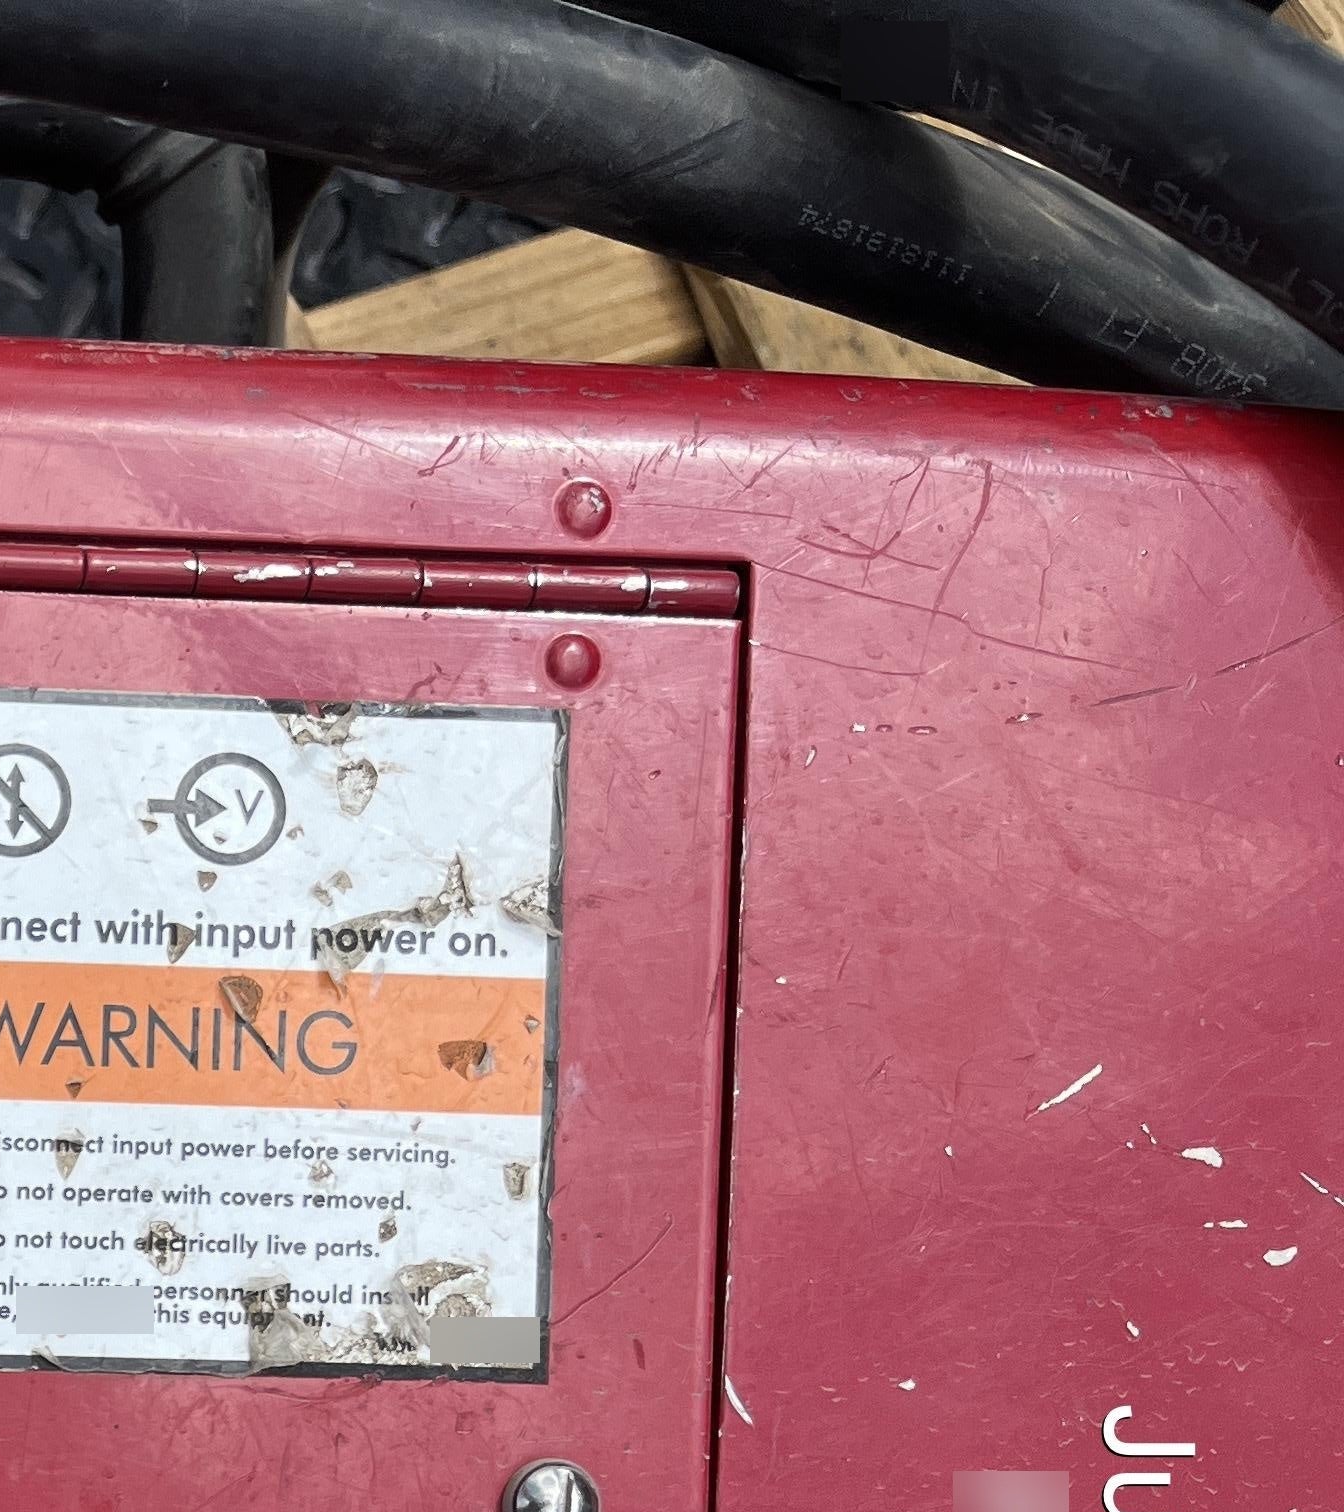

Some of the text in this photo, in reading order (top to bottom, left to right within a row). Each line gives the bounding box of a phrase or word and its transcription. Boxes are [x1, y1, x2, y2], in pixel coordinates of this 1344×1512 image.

[235, 788, 264, 825] V
[95, 908, 178, 946] with
[195, 910, 296, 958] input
[311, 925, 436, 961] power
[449, 931, 509, 958] on.
[112, 1133, 173, 1160] input
[181, 1141, 256, 1162] power
[264, 1138, 339, 1161] before
[347, 1142, 456, 1168] servicing.
[17, 1183, 54, 1200] not
[63, 1185, 153, 1206] operate
[162, 1184, 211, 1205] with
[219, 1191, 294, 1207] covers
[302, 1190, 412, 1211] removed.
[15, 1231, 53, 1248] not
[61, 1230, 125, 1250] touch
[134, 1230, 258, 1258] electrically
[266, 1234, 307, 1255] live
[315, 1239, 380, 1260] parts.
[275, 1283, 353, 1304] should
[361, 1284, 430, 1306] insll
[153, 1302, 190, 1324] his
